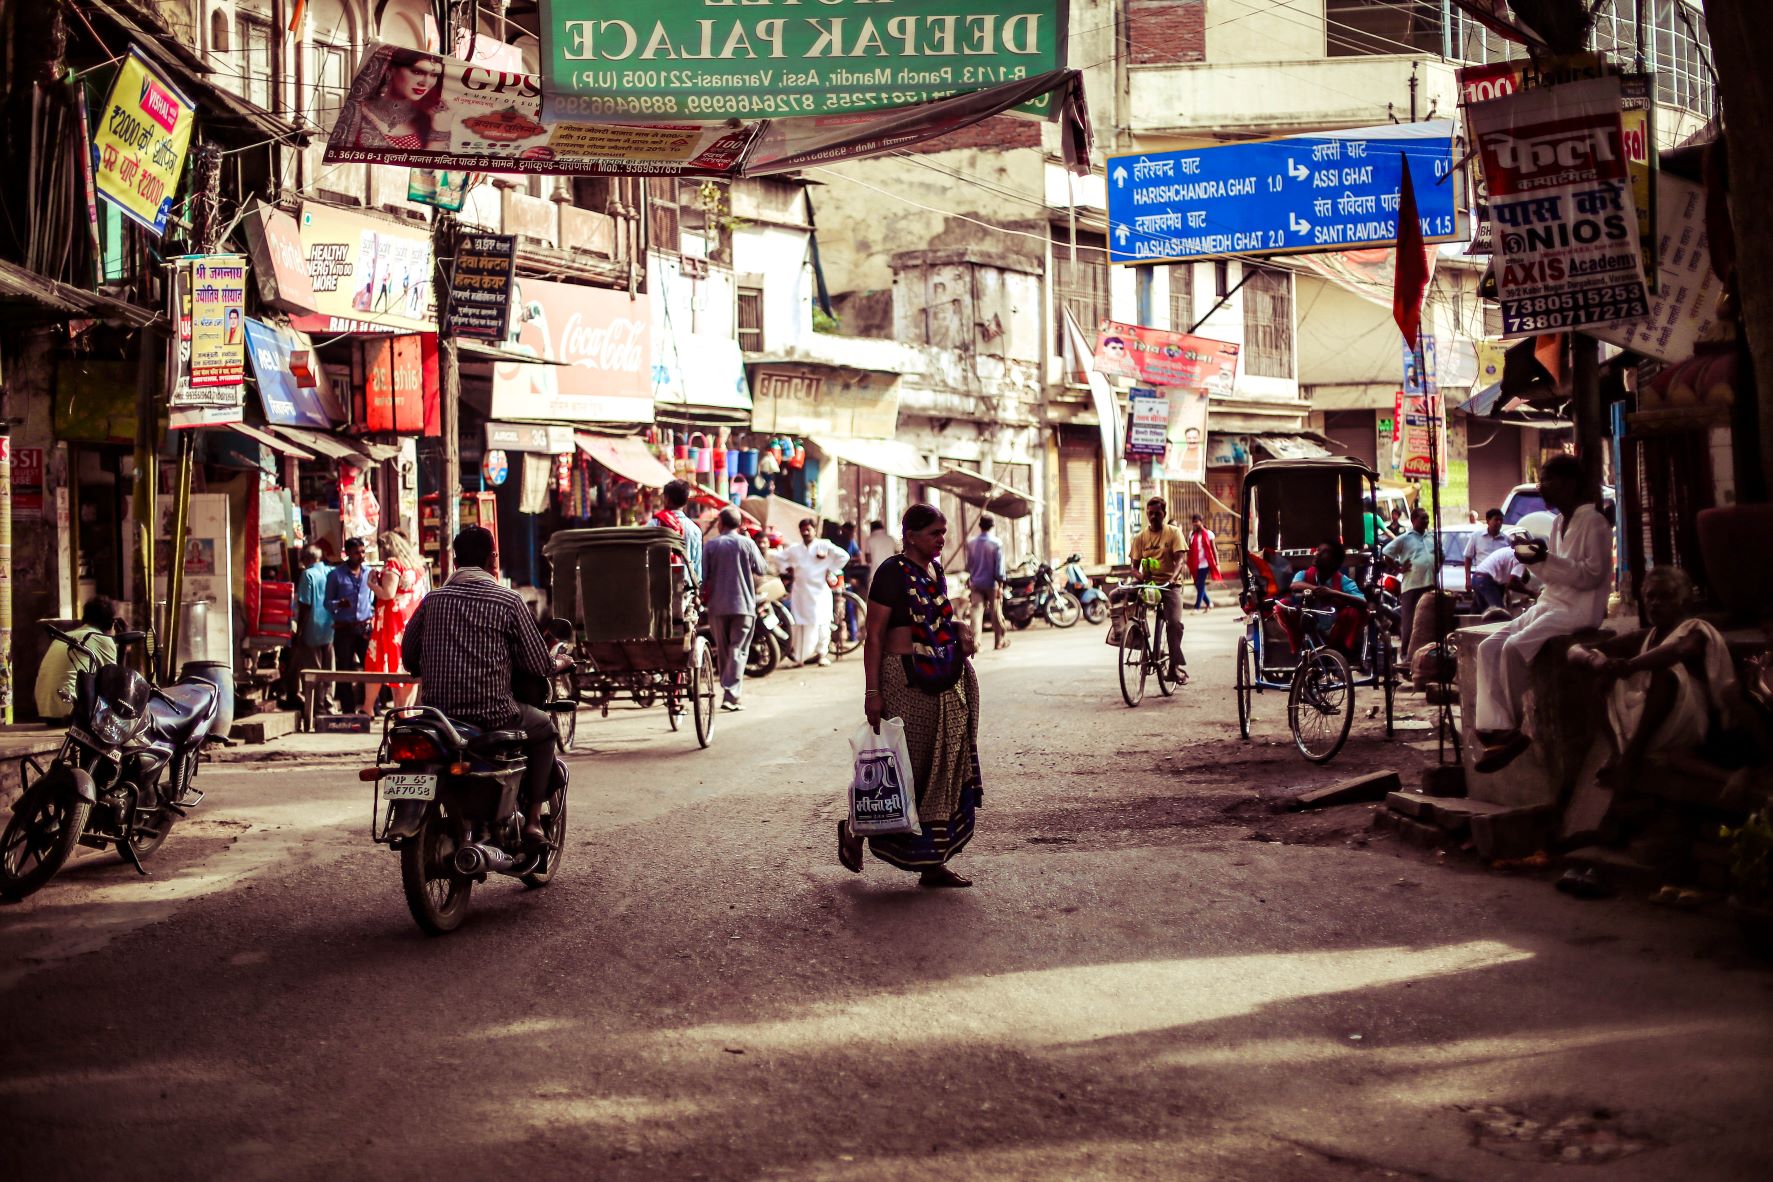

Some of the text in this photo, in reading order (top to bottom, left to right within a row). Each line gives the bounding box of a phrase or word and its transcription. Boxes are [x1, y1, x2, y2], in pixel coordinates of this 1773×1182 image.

[136, 124, 155, 156] की
[1312, 139, 1368, 162] अस्सी घाट
[1482, 125, 1619, 175] फेल
[103, 142, 120, 173] पर
[339, 151, 366, 160] 36/36
[367, 153, 382, 161] B-1
[384, 152, 408, 164] तुलसी
[409, 153, 432, 164] मानस
[434, 154, 458, 166] मन्दिर
[478, 157, 490, 168] के
[1133, 156, 1200, 182] हरिश्चन्द्र घाट
[1133, 174, 1283, 205] HARISHCHANDRA GHAT 1.0
[1313, 170, 1339, 188] ASSI
[1342, 166, 1373, 186] GHAT
[1313, 197, 1332, 218] संत
[1337, 191, 1376, 216] रविदास
[1493, 195, 1563, 228] पास
[1135, 208, 1207, 234] दशाश्वमेध घाट
[1314, 224, 1345, 244] SANT
[1346, 220, 1395, 241] RAVIDAS
[1435, 215, 1452, 235] 1.5
[1526, 214, 1628, 253] NIOS
[311, 245, 349, 261] HEALTHY
[1135, 229, 1285, 259] DASHASHWAMEDH GHAT 2.0
[196, 264, 207, 280] श्री
[312, 276, 338, 292] MORE
[1501, 253, 1637, 289] AXIS Academy
[195, 284, 219, 303] ज्योतिष
[1506, 284, 1642, 316] 7380515253
[1508, 301, 1644, 333] 7380717273
[531, 429, 547, 447] 3G
[392, 775, 427, 784] UP 65
[856, 792, 902, 814] मीनाक्षी
